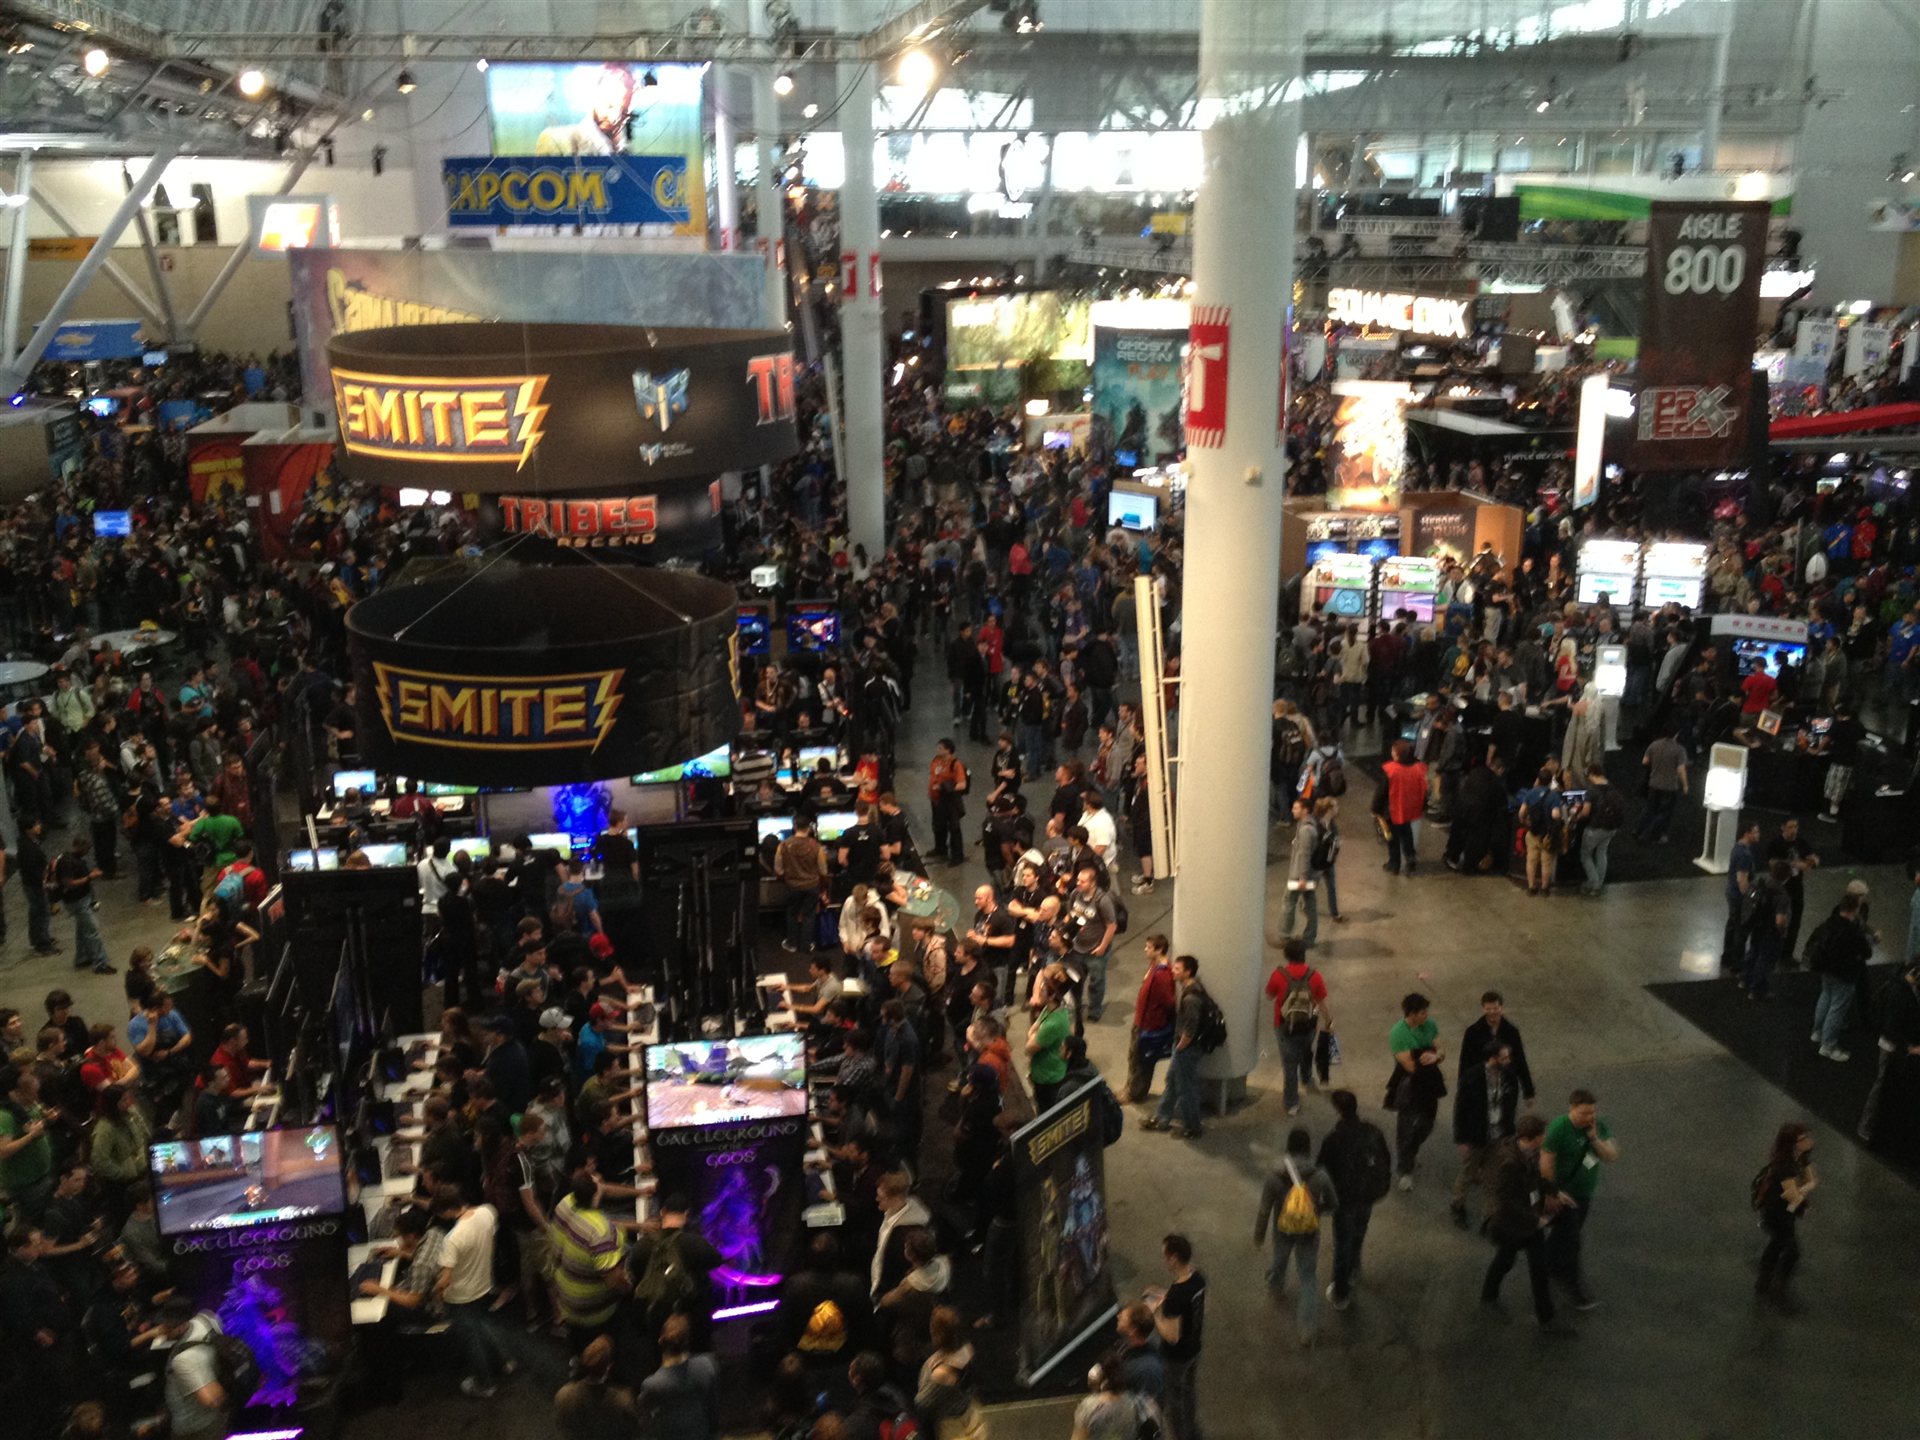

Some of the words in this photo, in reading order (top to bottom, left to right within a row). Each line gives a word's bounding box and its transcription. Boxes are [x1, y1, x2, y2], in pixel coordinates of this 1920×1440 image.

[1677, 213, 1744, 240] AISLE
[1663, 245, 1747, 295] 800
[498, 494, 659, 539] TRIBES
[398, 680, 587, 737] SMITE
[1037, 1109, 1084, 1154] SMITE
